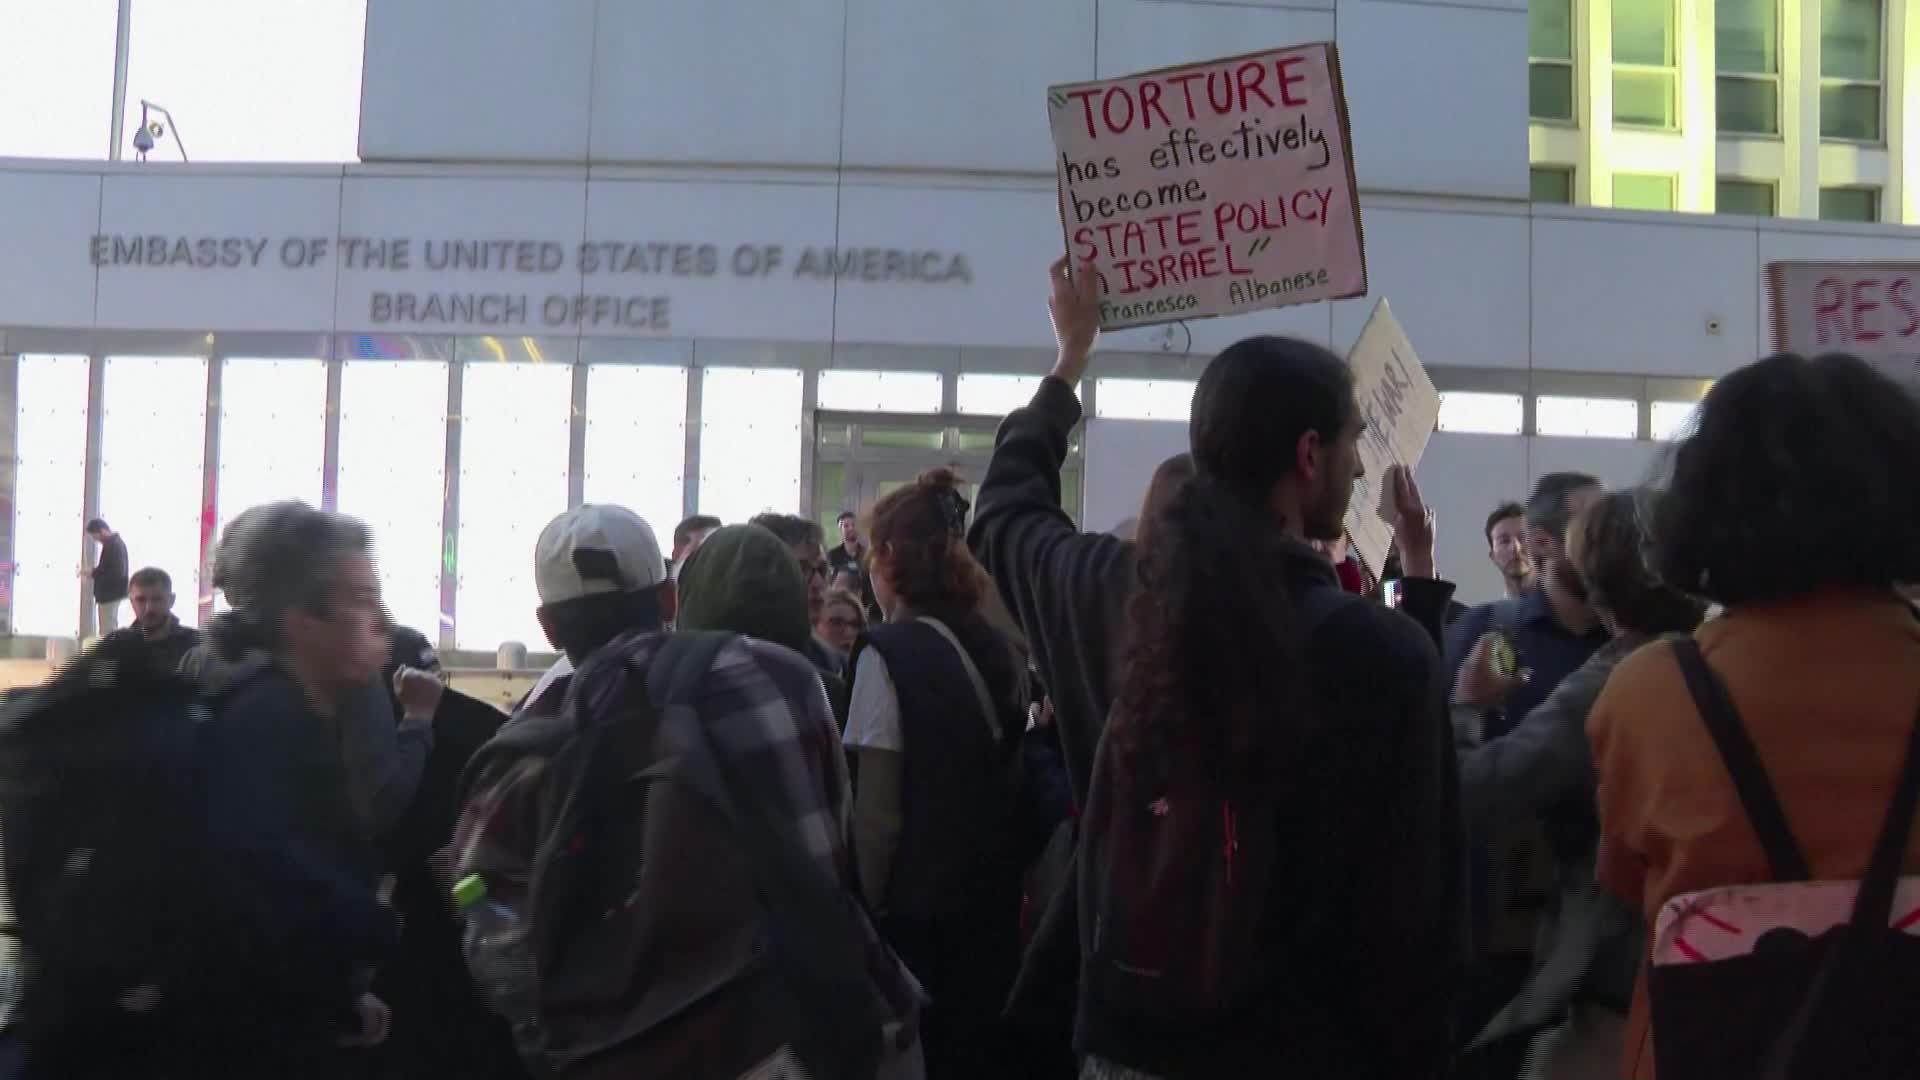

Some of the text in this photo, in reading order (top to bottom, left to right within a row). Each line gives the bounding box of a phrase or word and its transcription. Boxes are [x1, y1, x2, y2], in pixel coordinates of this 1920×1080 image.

[1061, 114, 1329, 186] has effectively
[1071, 178, 1207, 223] become
[1073, 190, 1332, 263] STATE POLICY
[88, 234, 973, 285] EMBASSY OF THE UNITED STATES OF AMERICA
[370, 291, 673, 329] BRANCH OFFICE
[1099, 268, 1329, 322] Francesca Albanese
